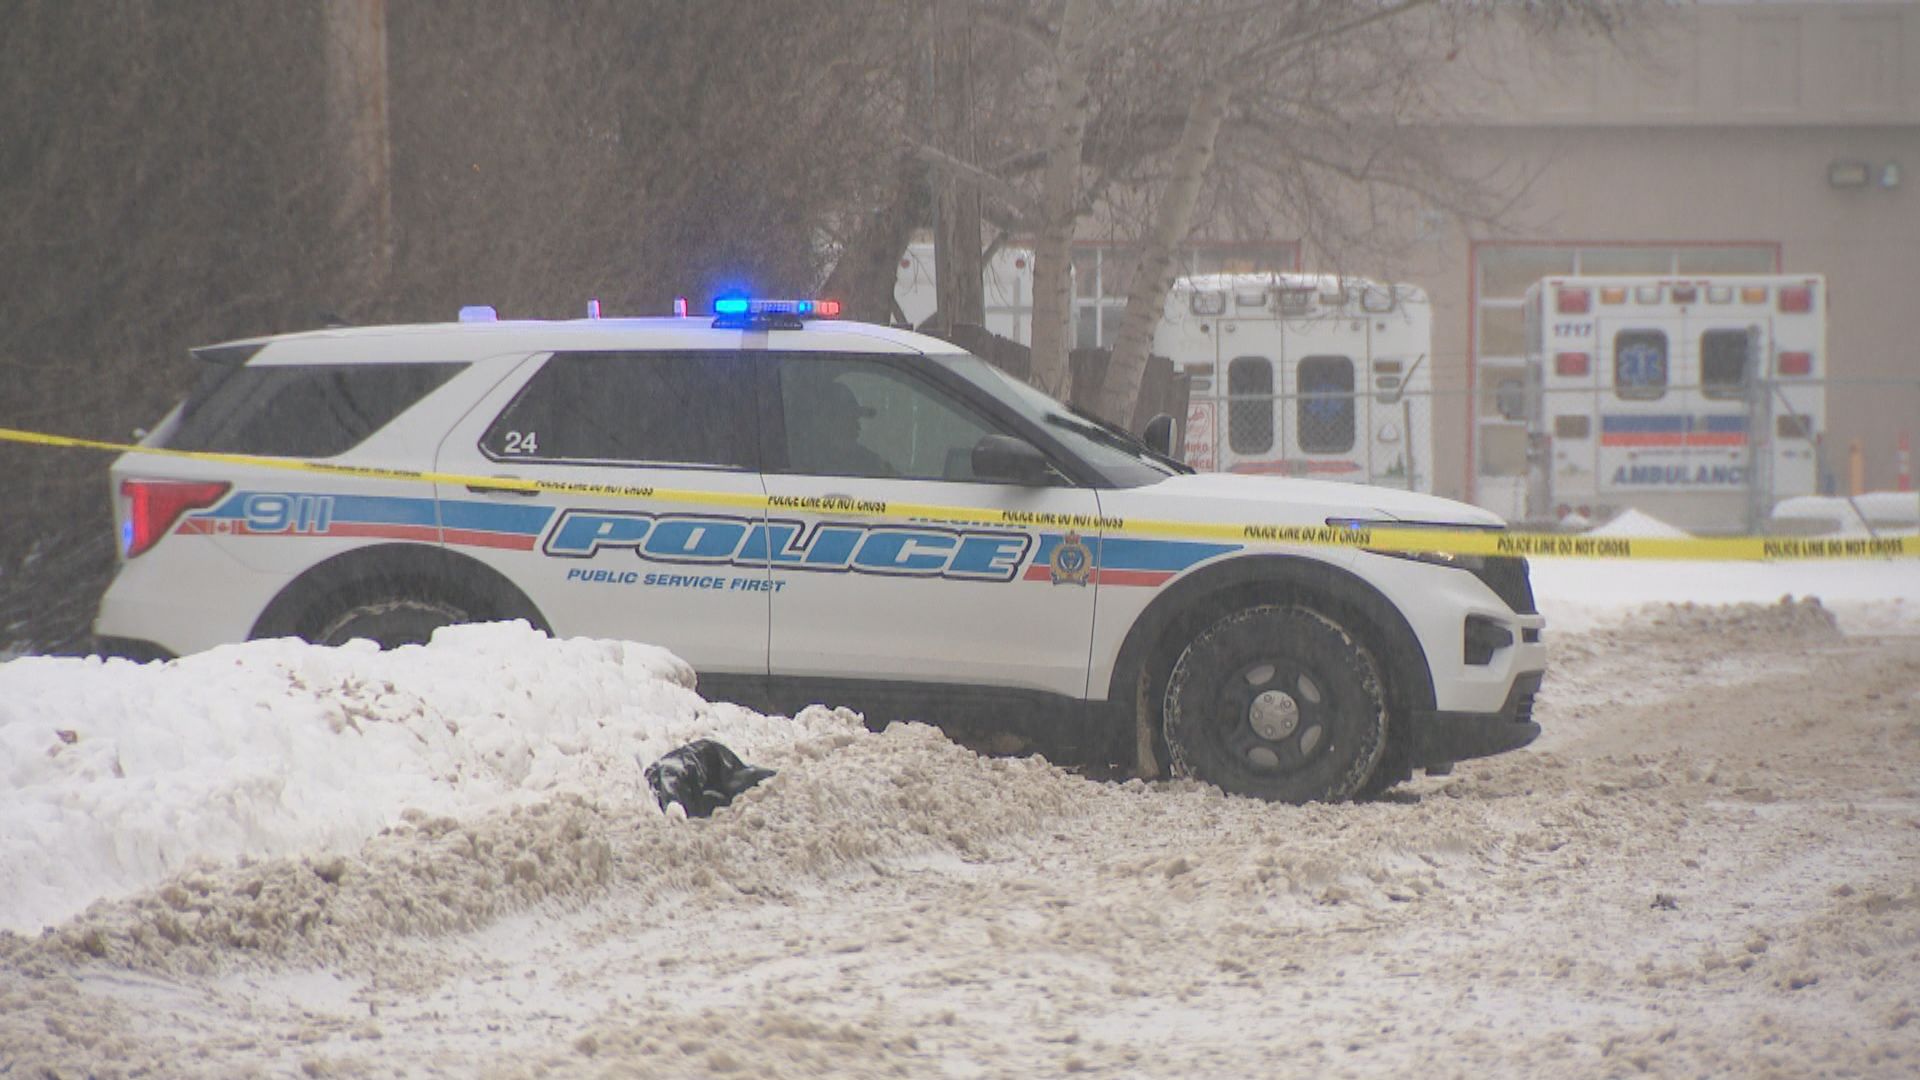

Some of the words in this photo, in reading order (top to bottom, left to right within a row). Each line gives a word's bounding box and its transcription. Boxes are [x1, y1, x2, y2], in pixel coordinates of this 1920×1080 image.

[1552, 324, 1592, 337] 1717
[504, 431, 538, 454] 24
[1611, 465, 1750, 485] AMBULANC
[244, 494, 335, 533] 911
[543, 508, 1033, 583] POLICE
[1244, 525, 1277, 539] POLICE
[1279, 526, 1300, 540] LINE
[1302, 527, 1315, 541] DO
[1318, 528, 1337, 543] NOT
[1339, 529, 1371, 545] CROSS
[1497, 538, 1531, 553] POLICE
[1534, 538, 1555, 554] LINE
[1558, 539, 1572, 554] DO
[1575, 539, 1595, 556] NOT
[1597, 539, 1631, 557] CROSS
[567, 568, 638, 584] PUBLIC
[643, 573, 726, 589] SERVICE
[730, 577, 786, 593] FIRST
